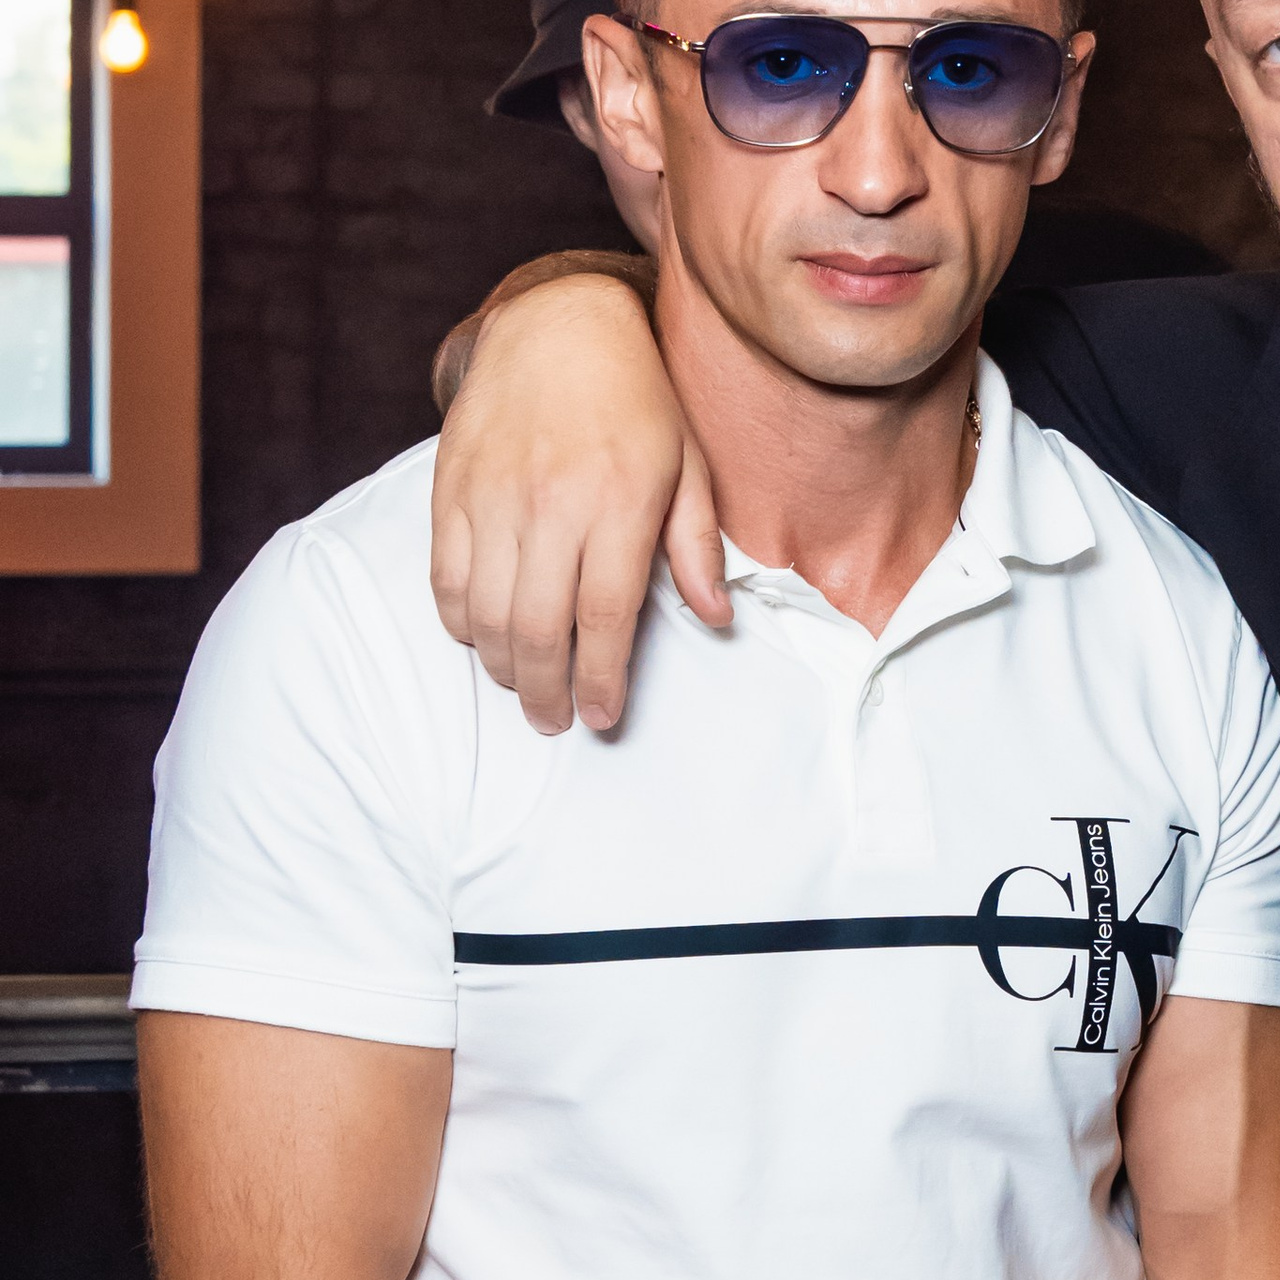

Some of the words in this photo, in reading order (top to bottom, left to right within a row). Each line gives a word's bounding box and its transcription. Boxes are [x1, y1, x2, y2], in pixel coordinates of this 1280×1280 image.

[1087, 823, 1112, 898] Jeans
[1093, 903, 1113, 961] Klein
[1084, 966, 1111, 1045] Calvin
